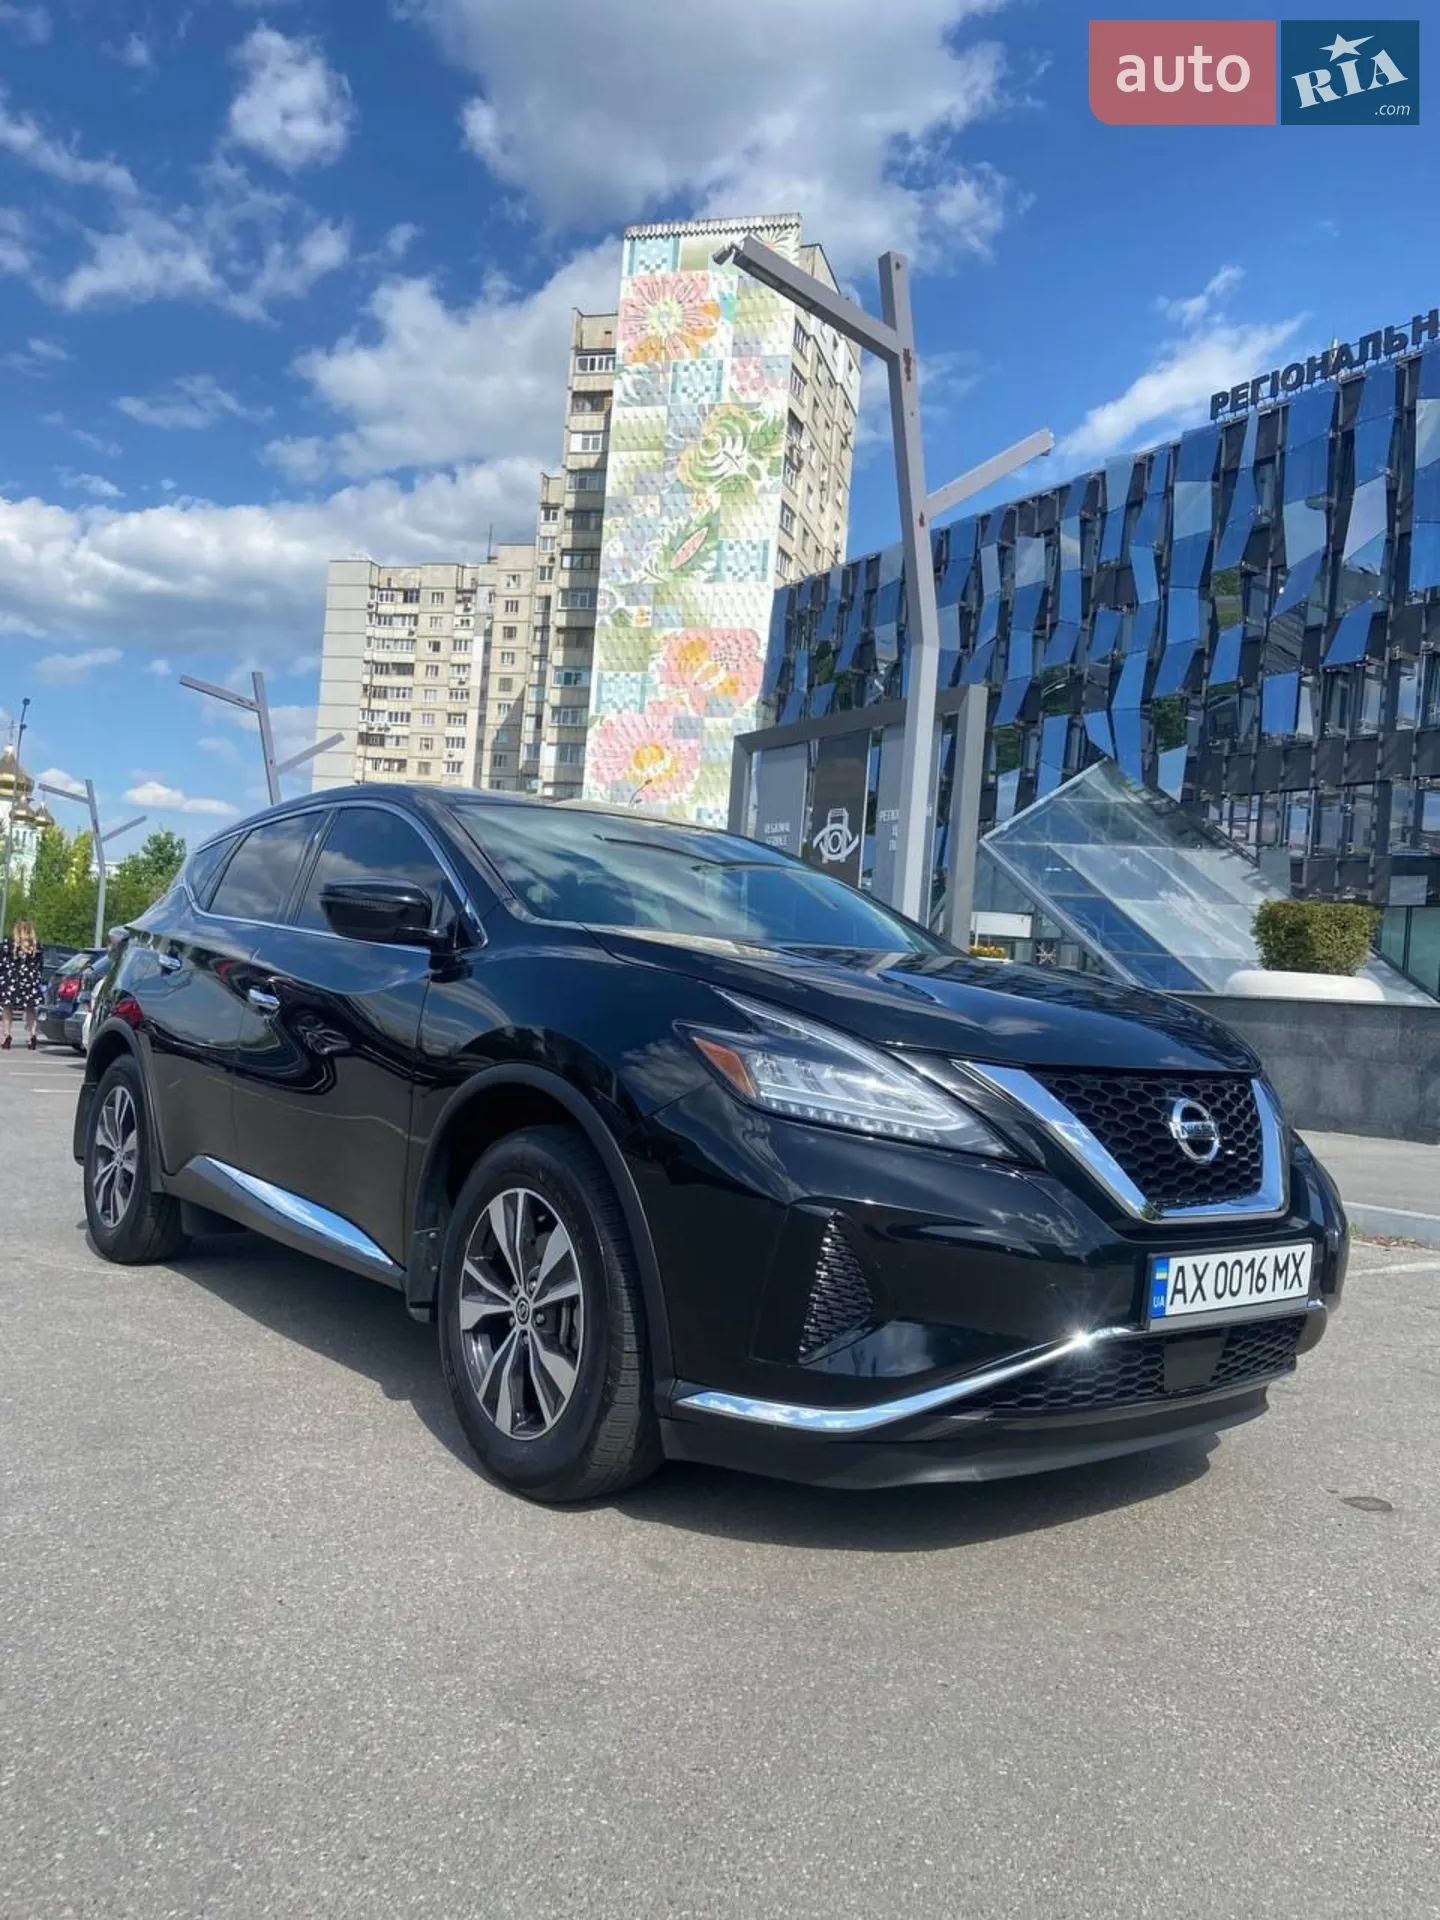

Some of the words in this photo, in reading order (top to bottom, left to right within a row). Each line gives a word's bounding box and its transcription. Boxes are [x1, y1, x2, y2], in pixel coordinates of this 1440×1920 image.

[1169, 1262, 1210, 1306] AX
[1213, 1256, 1268, 1300] 0016
[1271, 1251, 1306, 1293] MX
